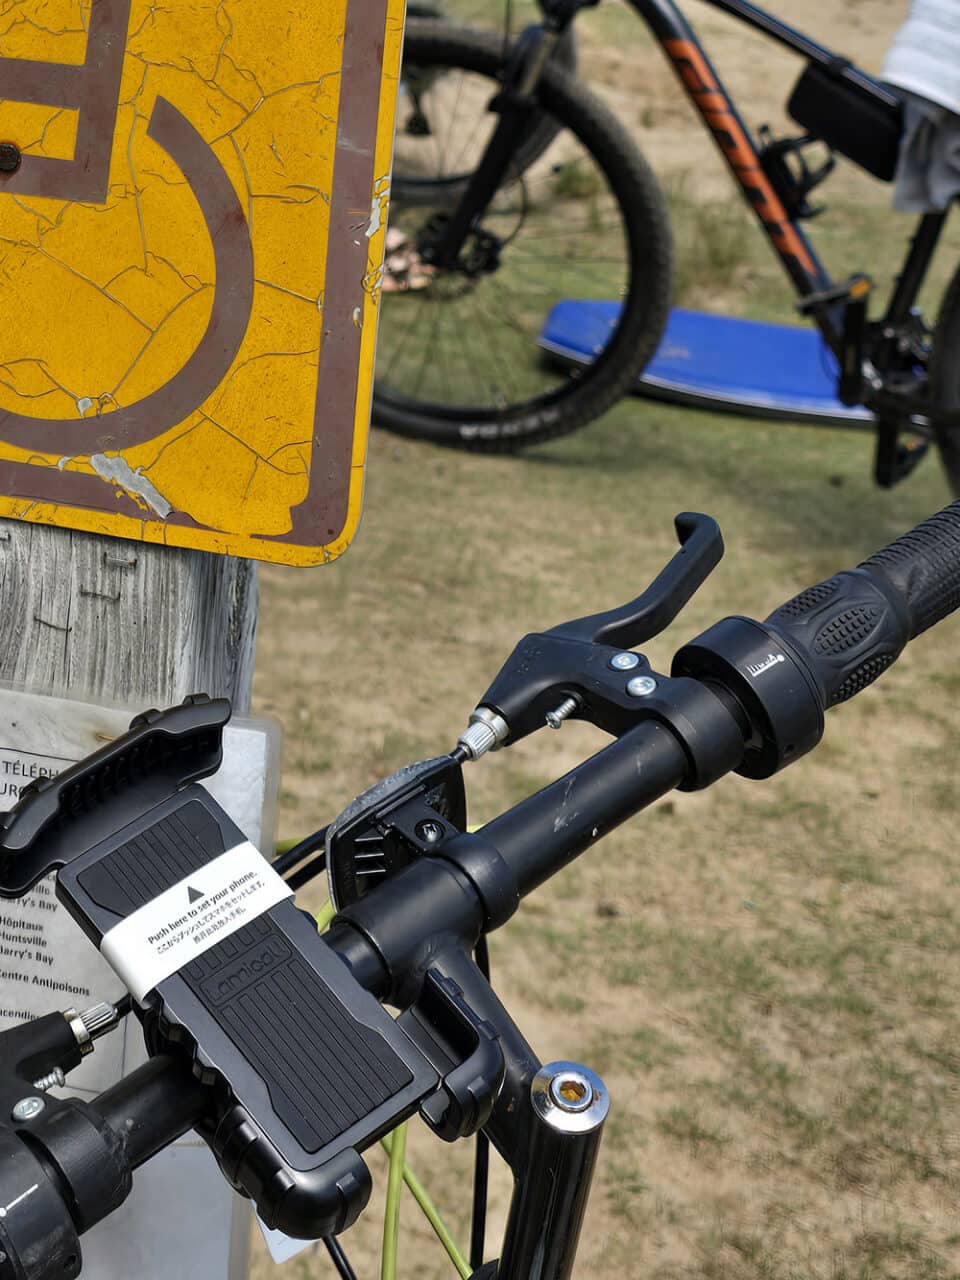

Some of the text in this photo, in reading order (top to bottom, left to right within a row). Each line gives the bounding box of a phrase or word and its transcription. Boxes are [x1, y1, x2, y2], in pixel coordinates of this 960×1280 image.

[38, 899, 58, 913] Bay
[147, 924, 170, 945] Push
[168, 914, 189, 932] here
[187, 908, 199, 921] to
[197, 898, 212, 913] set
[210, 886, 229, 906] your
[35, 950, 54, 966] Bay
[31, 975, 91, 997] Antipoisons
